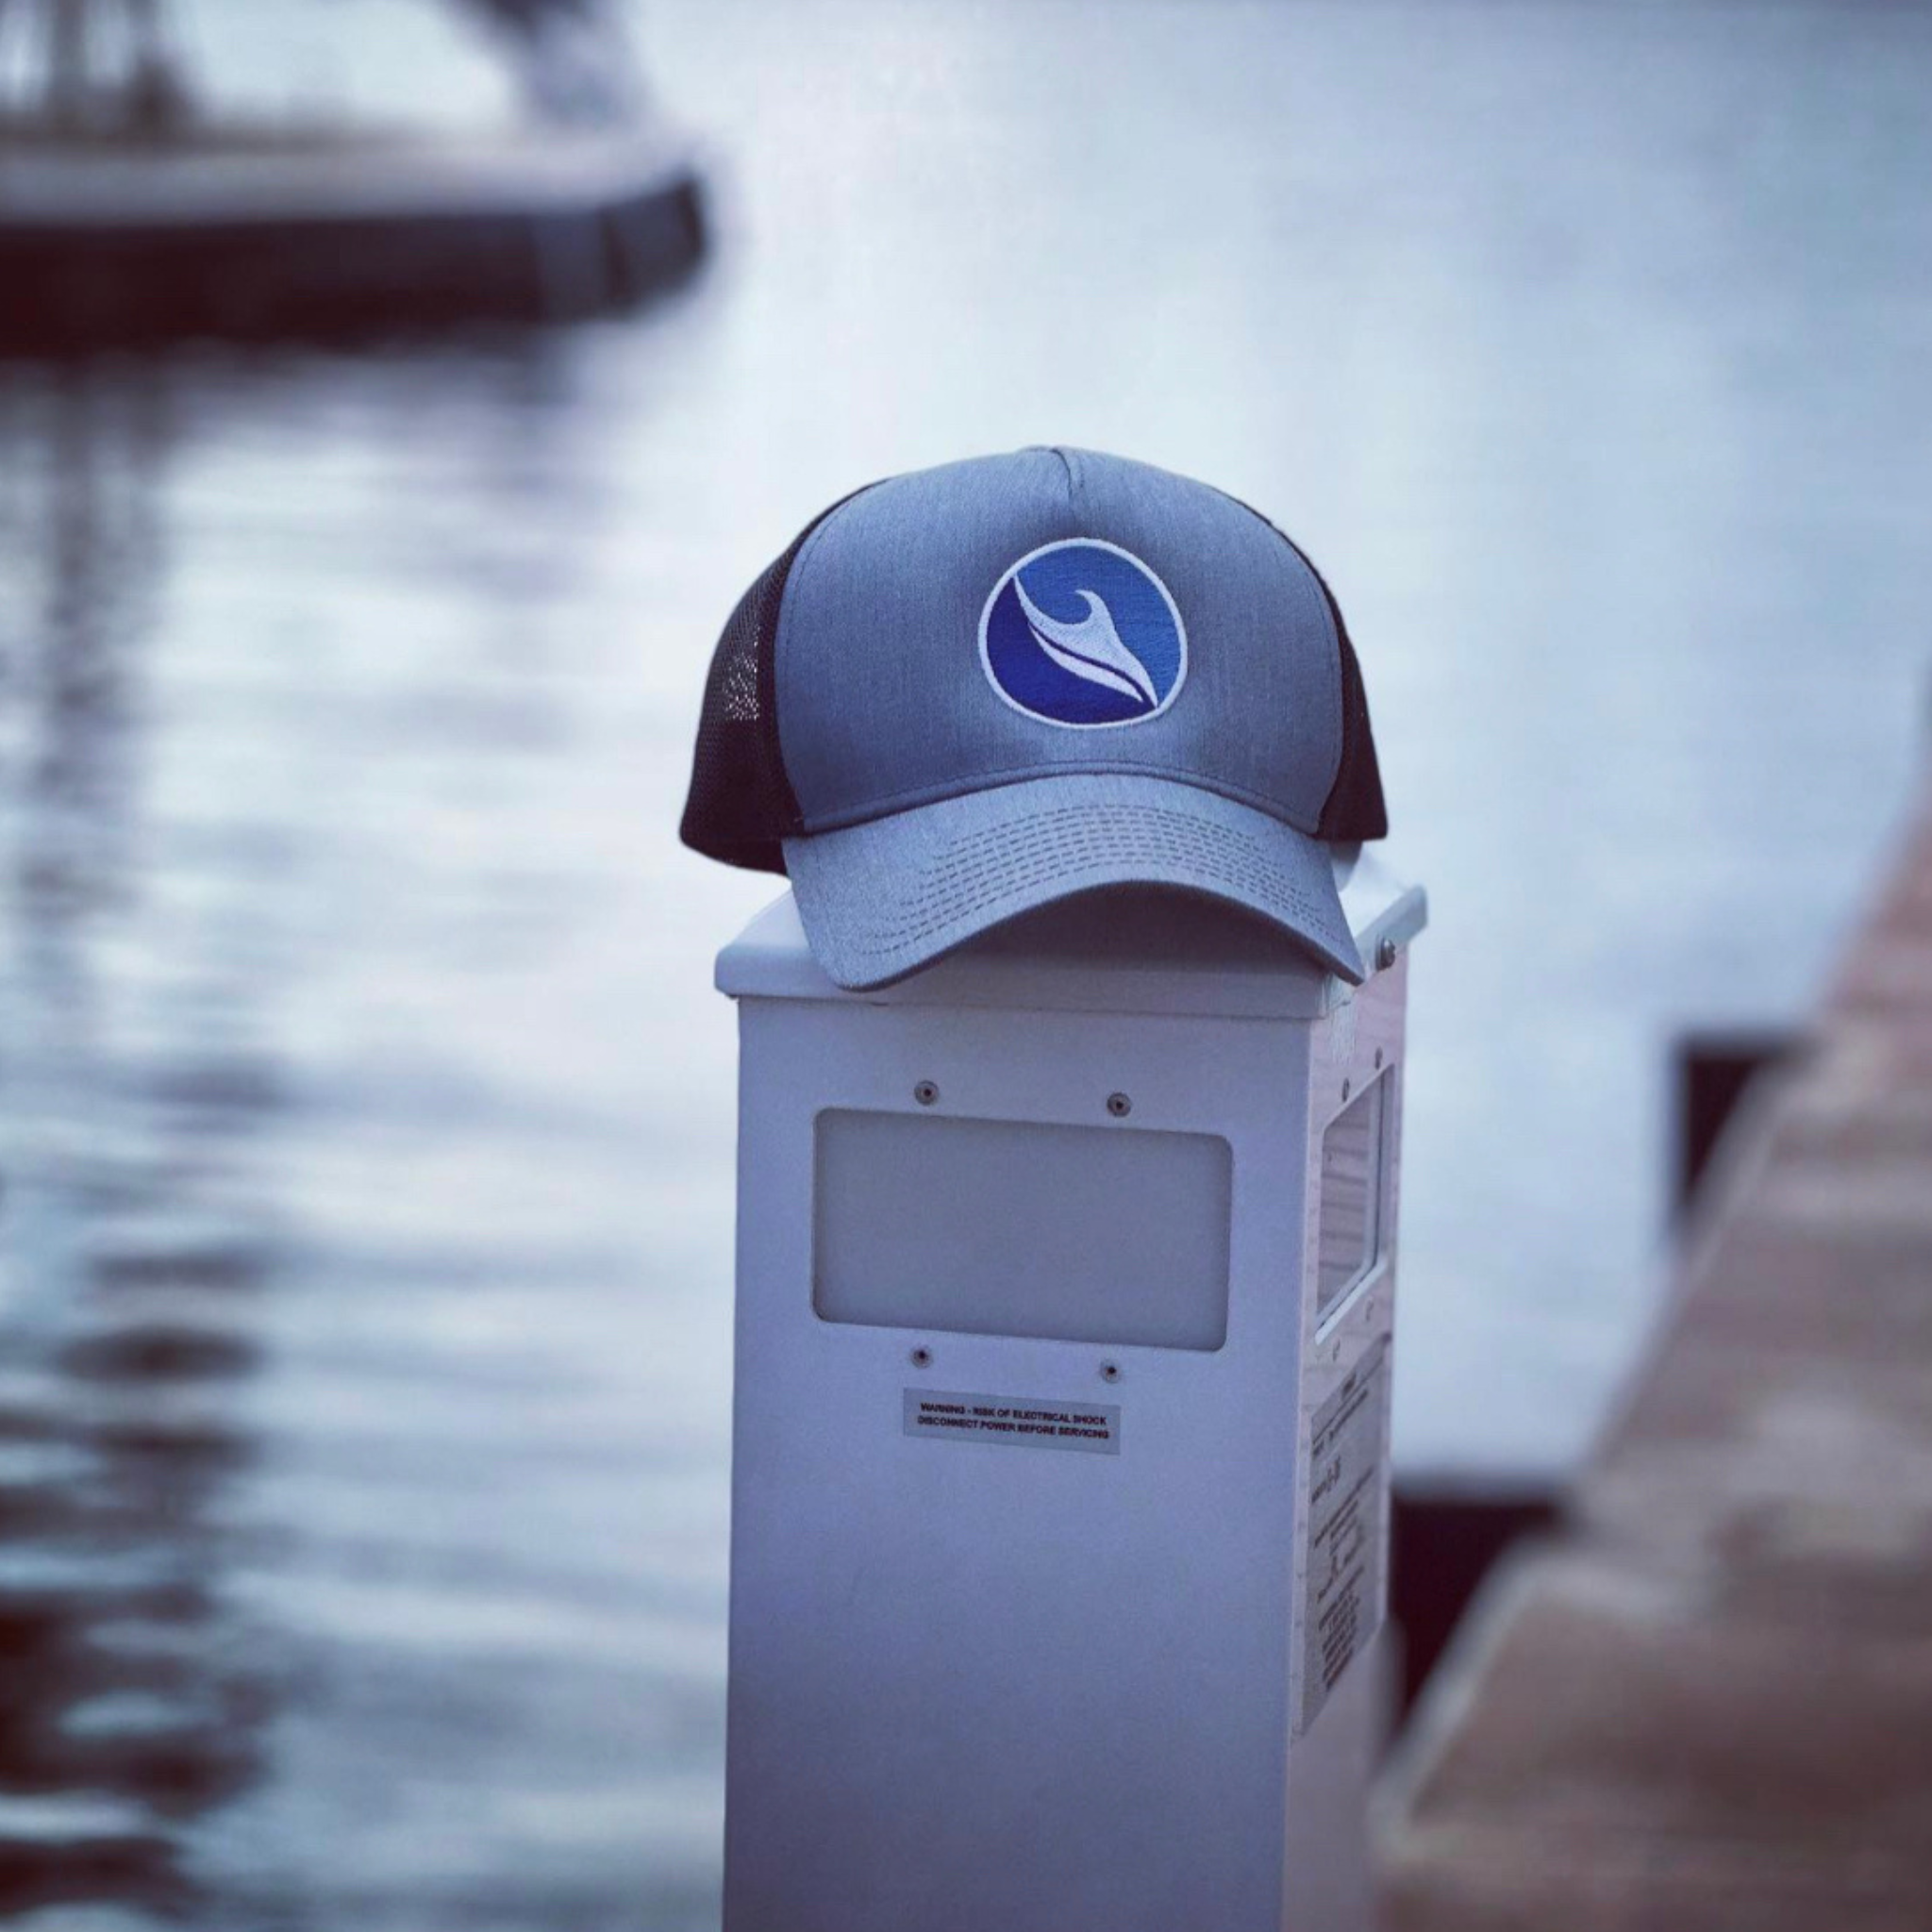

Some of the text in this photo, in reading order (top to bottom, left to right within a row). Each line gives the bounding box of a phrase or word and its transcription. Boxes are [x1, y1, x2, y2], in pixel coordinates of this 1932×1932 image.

[921, 1403, 965, 1414] WARNING
[974, 1407, 994, 1416] RISK
[997, 1408, 1008, 1418] OF
[1013, 1409, 1071, 1423] ELECTRICAL
[1074, 1415, 1106, 1425] SHOCK
[918, 1416, 1109, 1439] DISCONNECT POWER BEFORE SERVICING
